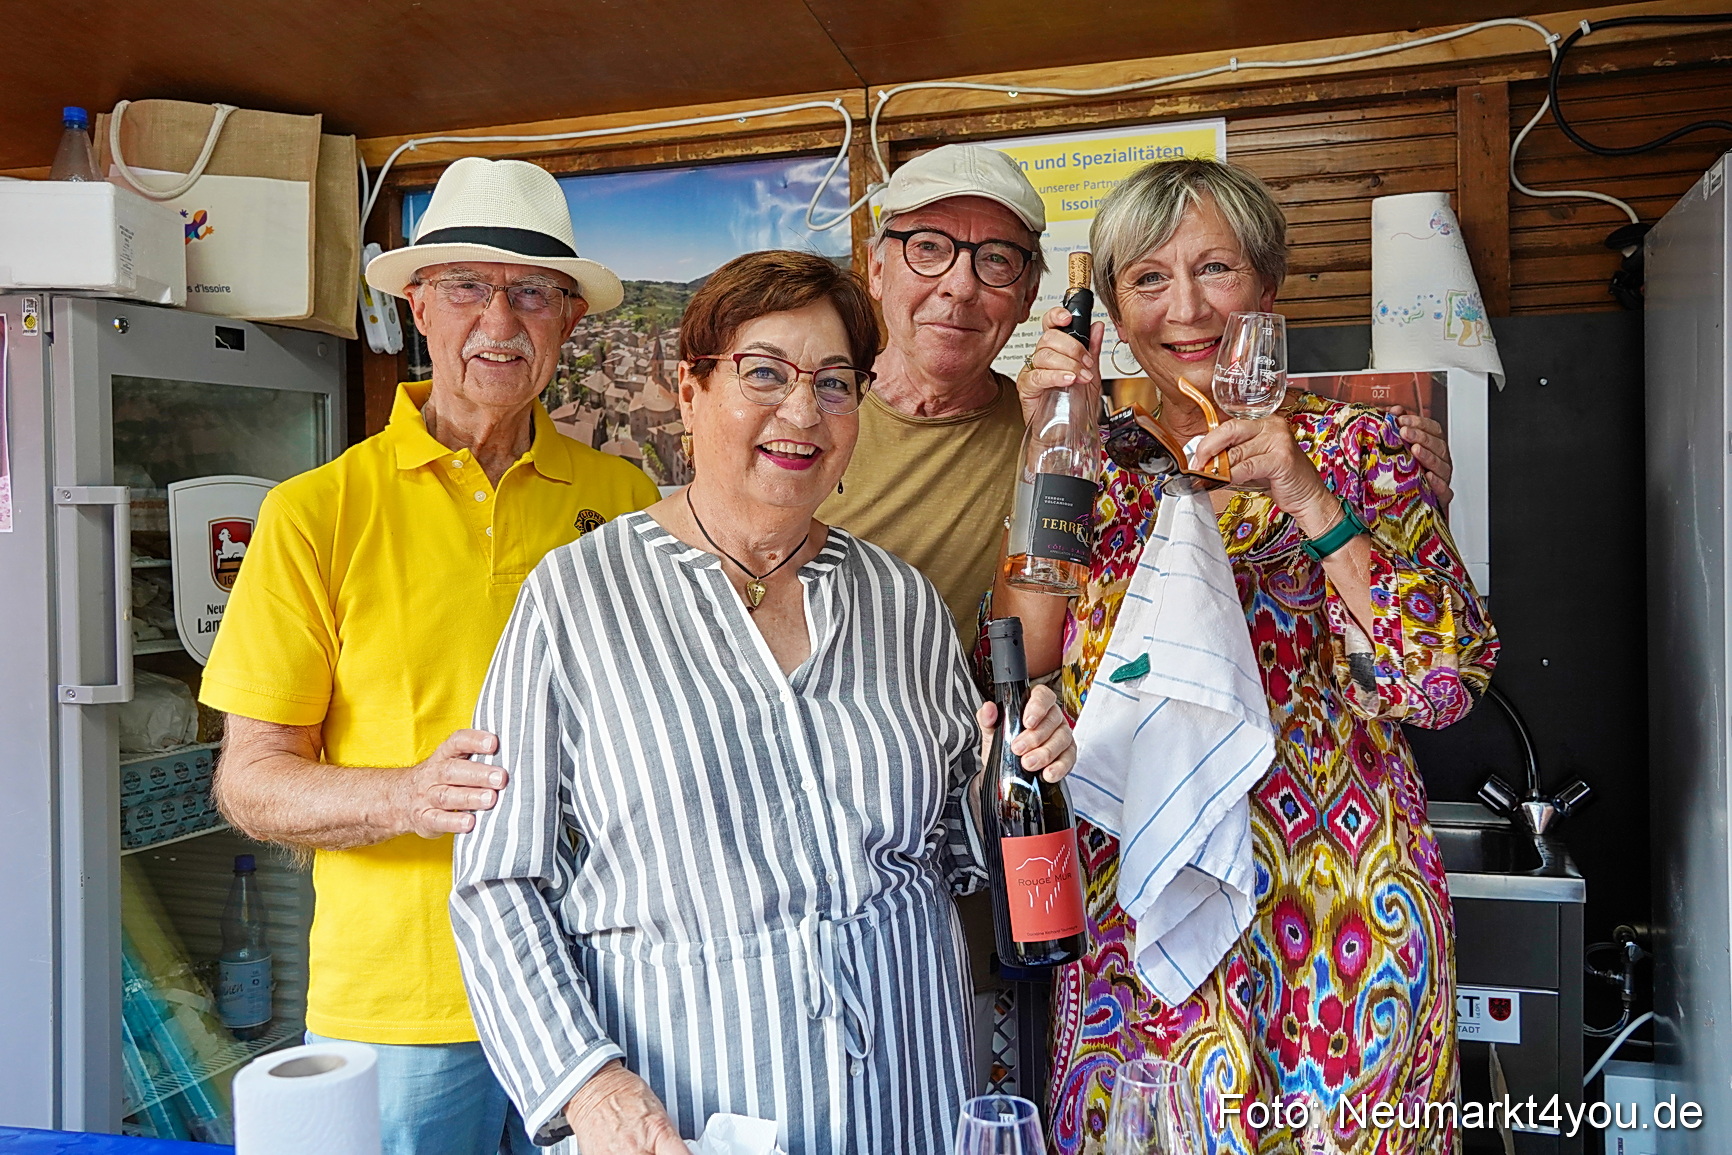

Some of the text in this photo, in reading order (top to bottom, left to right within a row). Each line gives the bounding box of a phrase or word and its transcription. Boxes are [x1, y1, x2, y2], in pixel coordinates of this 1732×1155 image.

[1034, 153, 1066, 171] und
[1072, 146, 1184, 170] Spezialitäten
[1039, 182, 1080, 194] unserer
[1061, 196, 1102, 211] Issoir
[195, 284, 231, 293] d'Issoire
[207, 603, 226, 616] Neu
[198, 618, 222, 634] Lam
[1018, 877, 1051, 886] ROUGE
[1458, 1025, 1481, 1034] TADT
